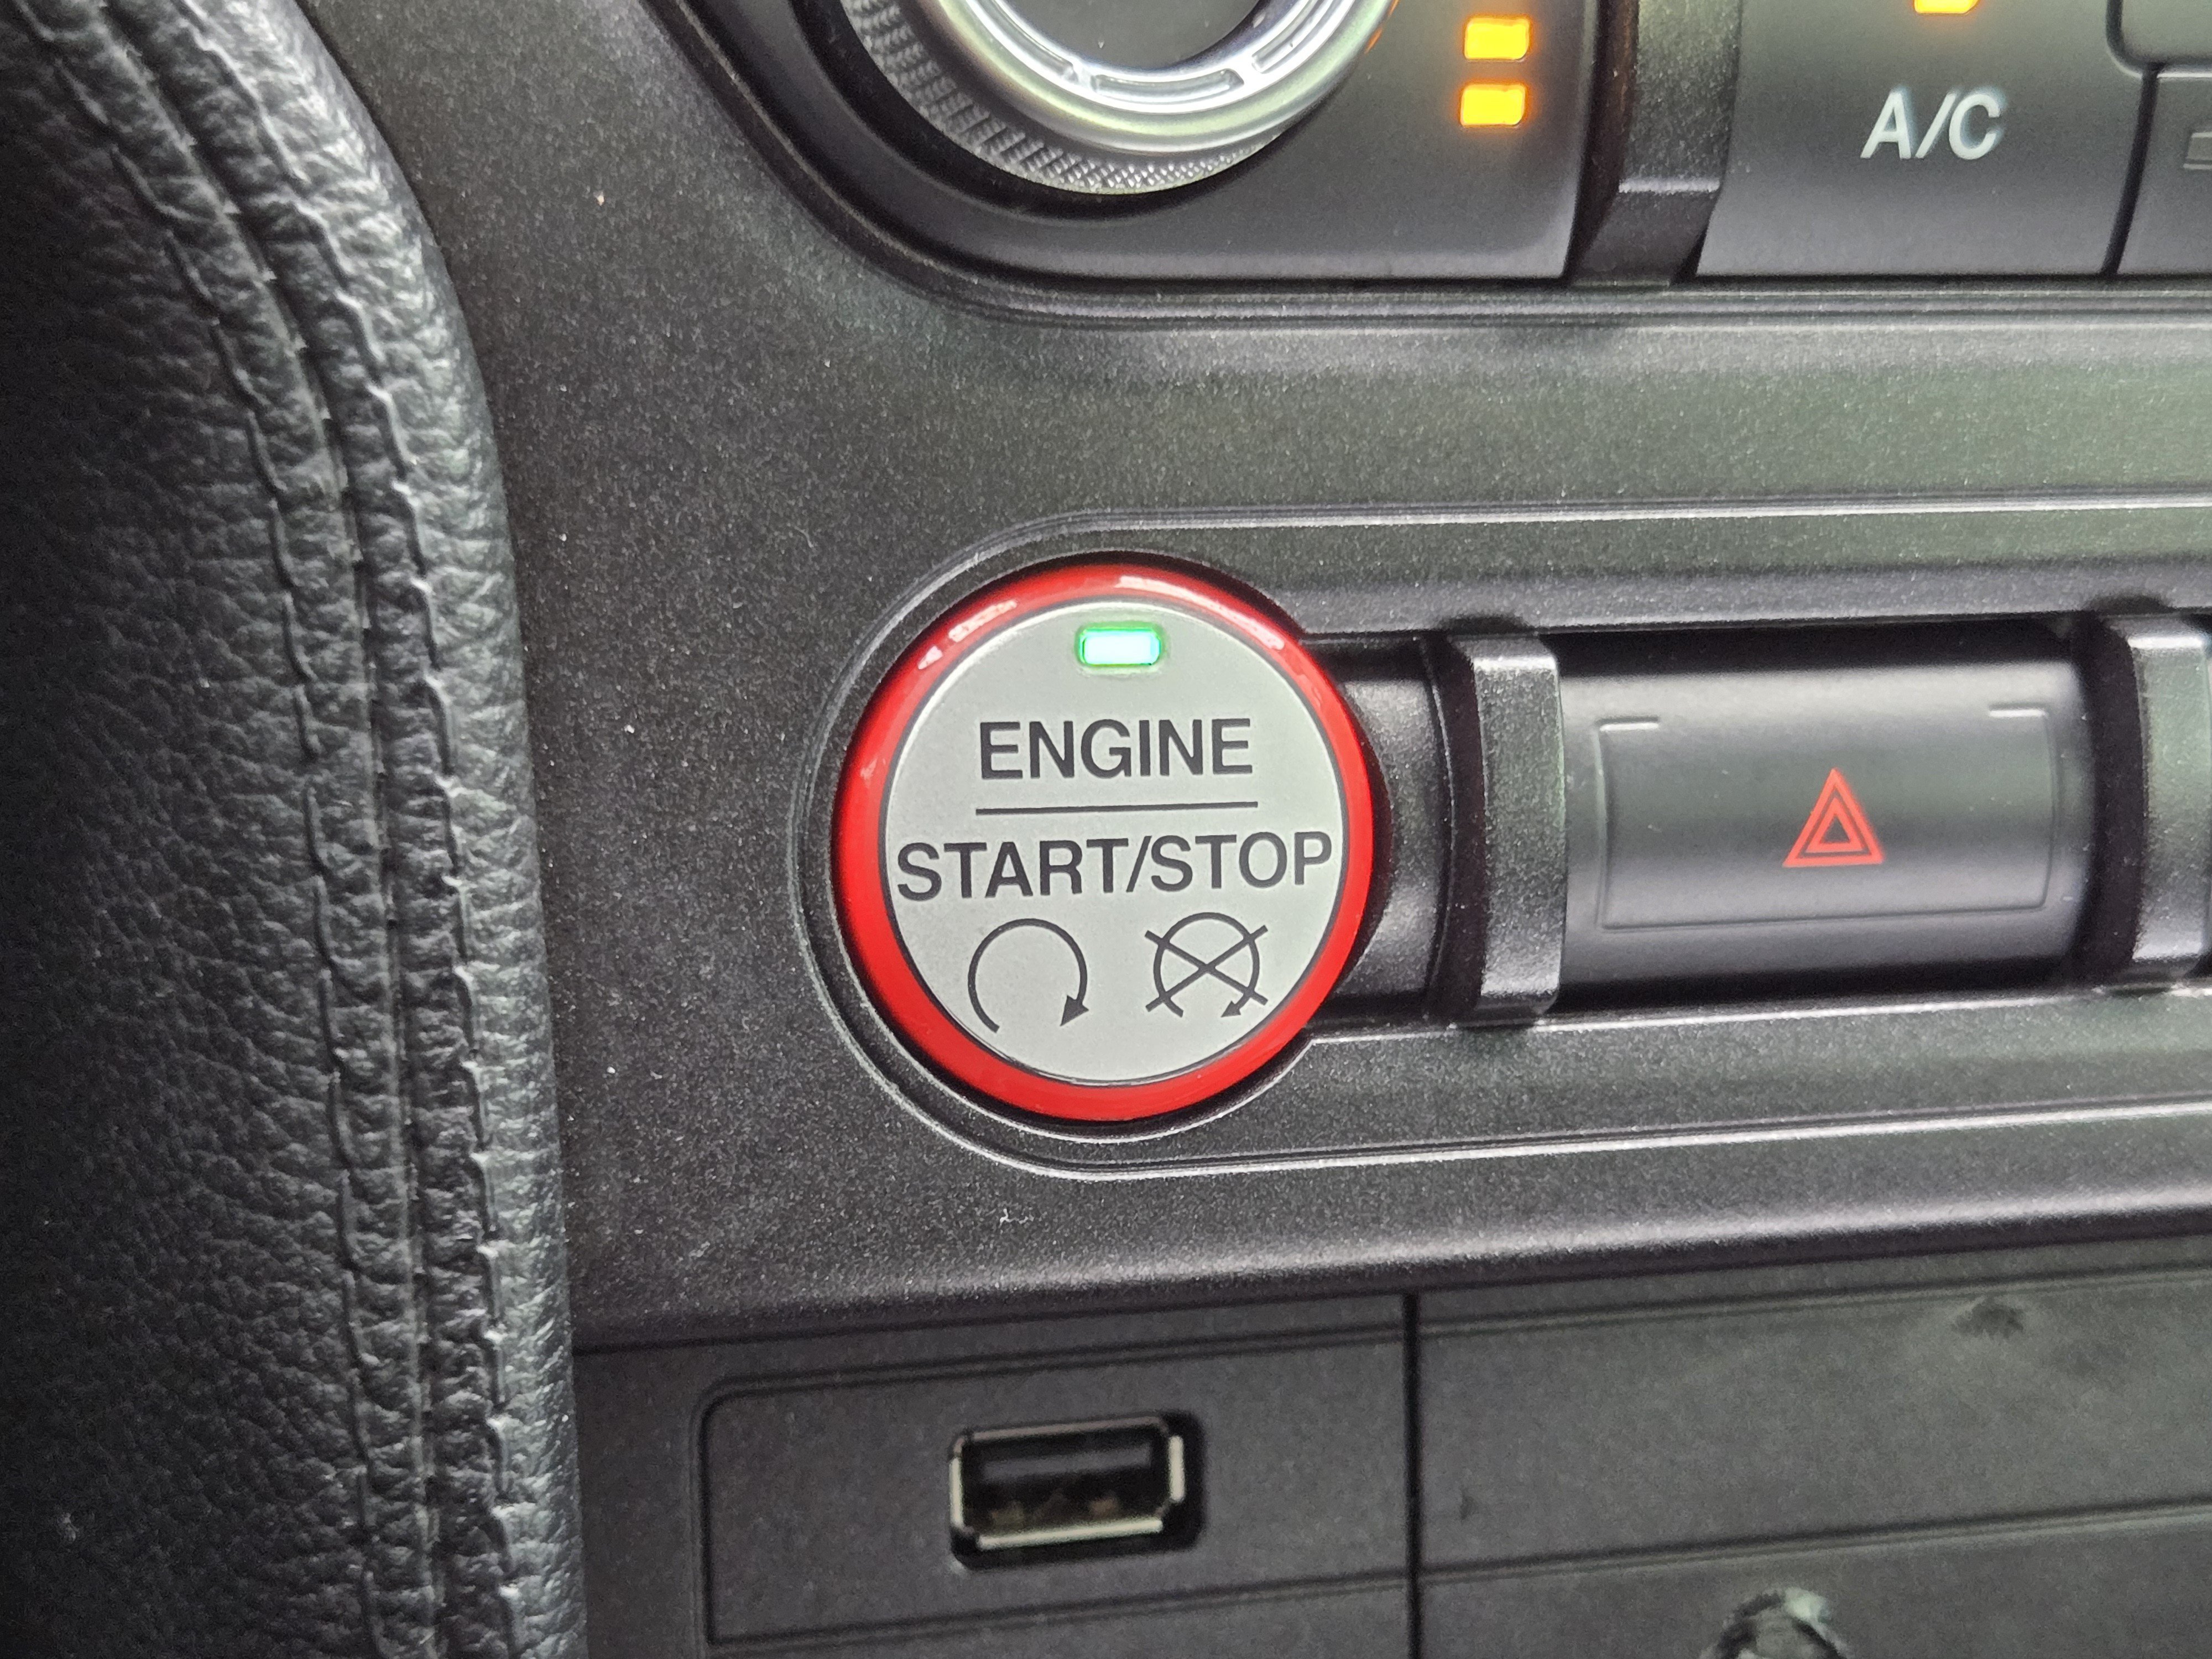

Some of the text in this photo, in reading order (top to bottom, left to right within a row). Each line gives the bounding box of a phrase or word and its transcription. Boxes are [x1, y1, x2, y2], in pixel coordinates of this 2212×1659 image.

[1860, 87, 2003, 160] A/C
[979, 717, 1253, 780] ENGINE
[897, 831, 1333, 900] START/STOP
